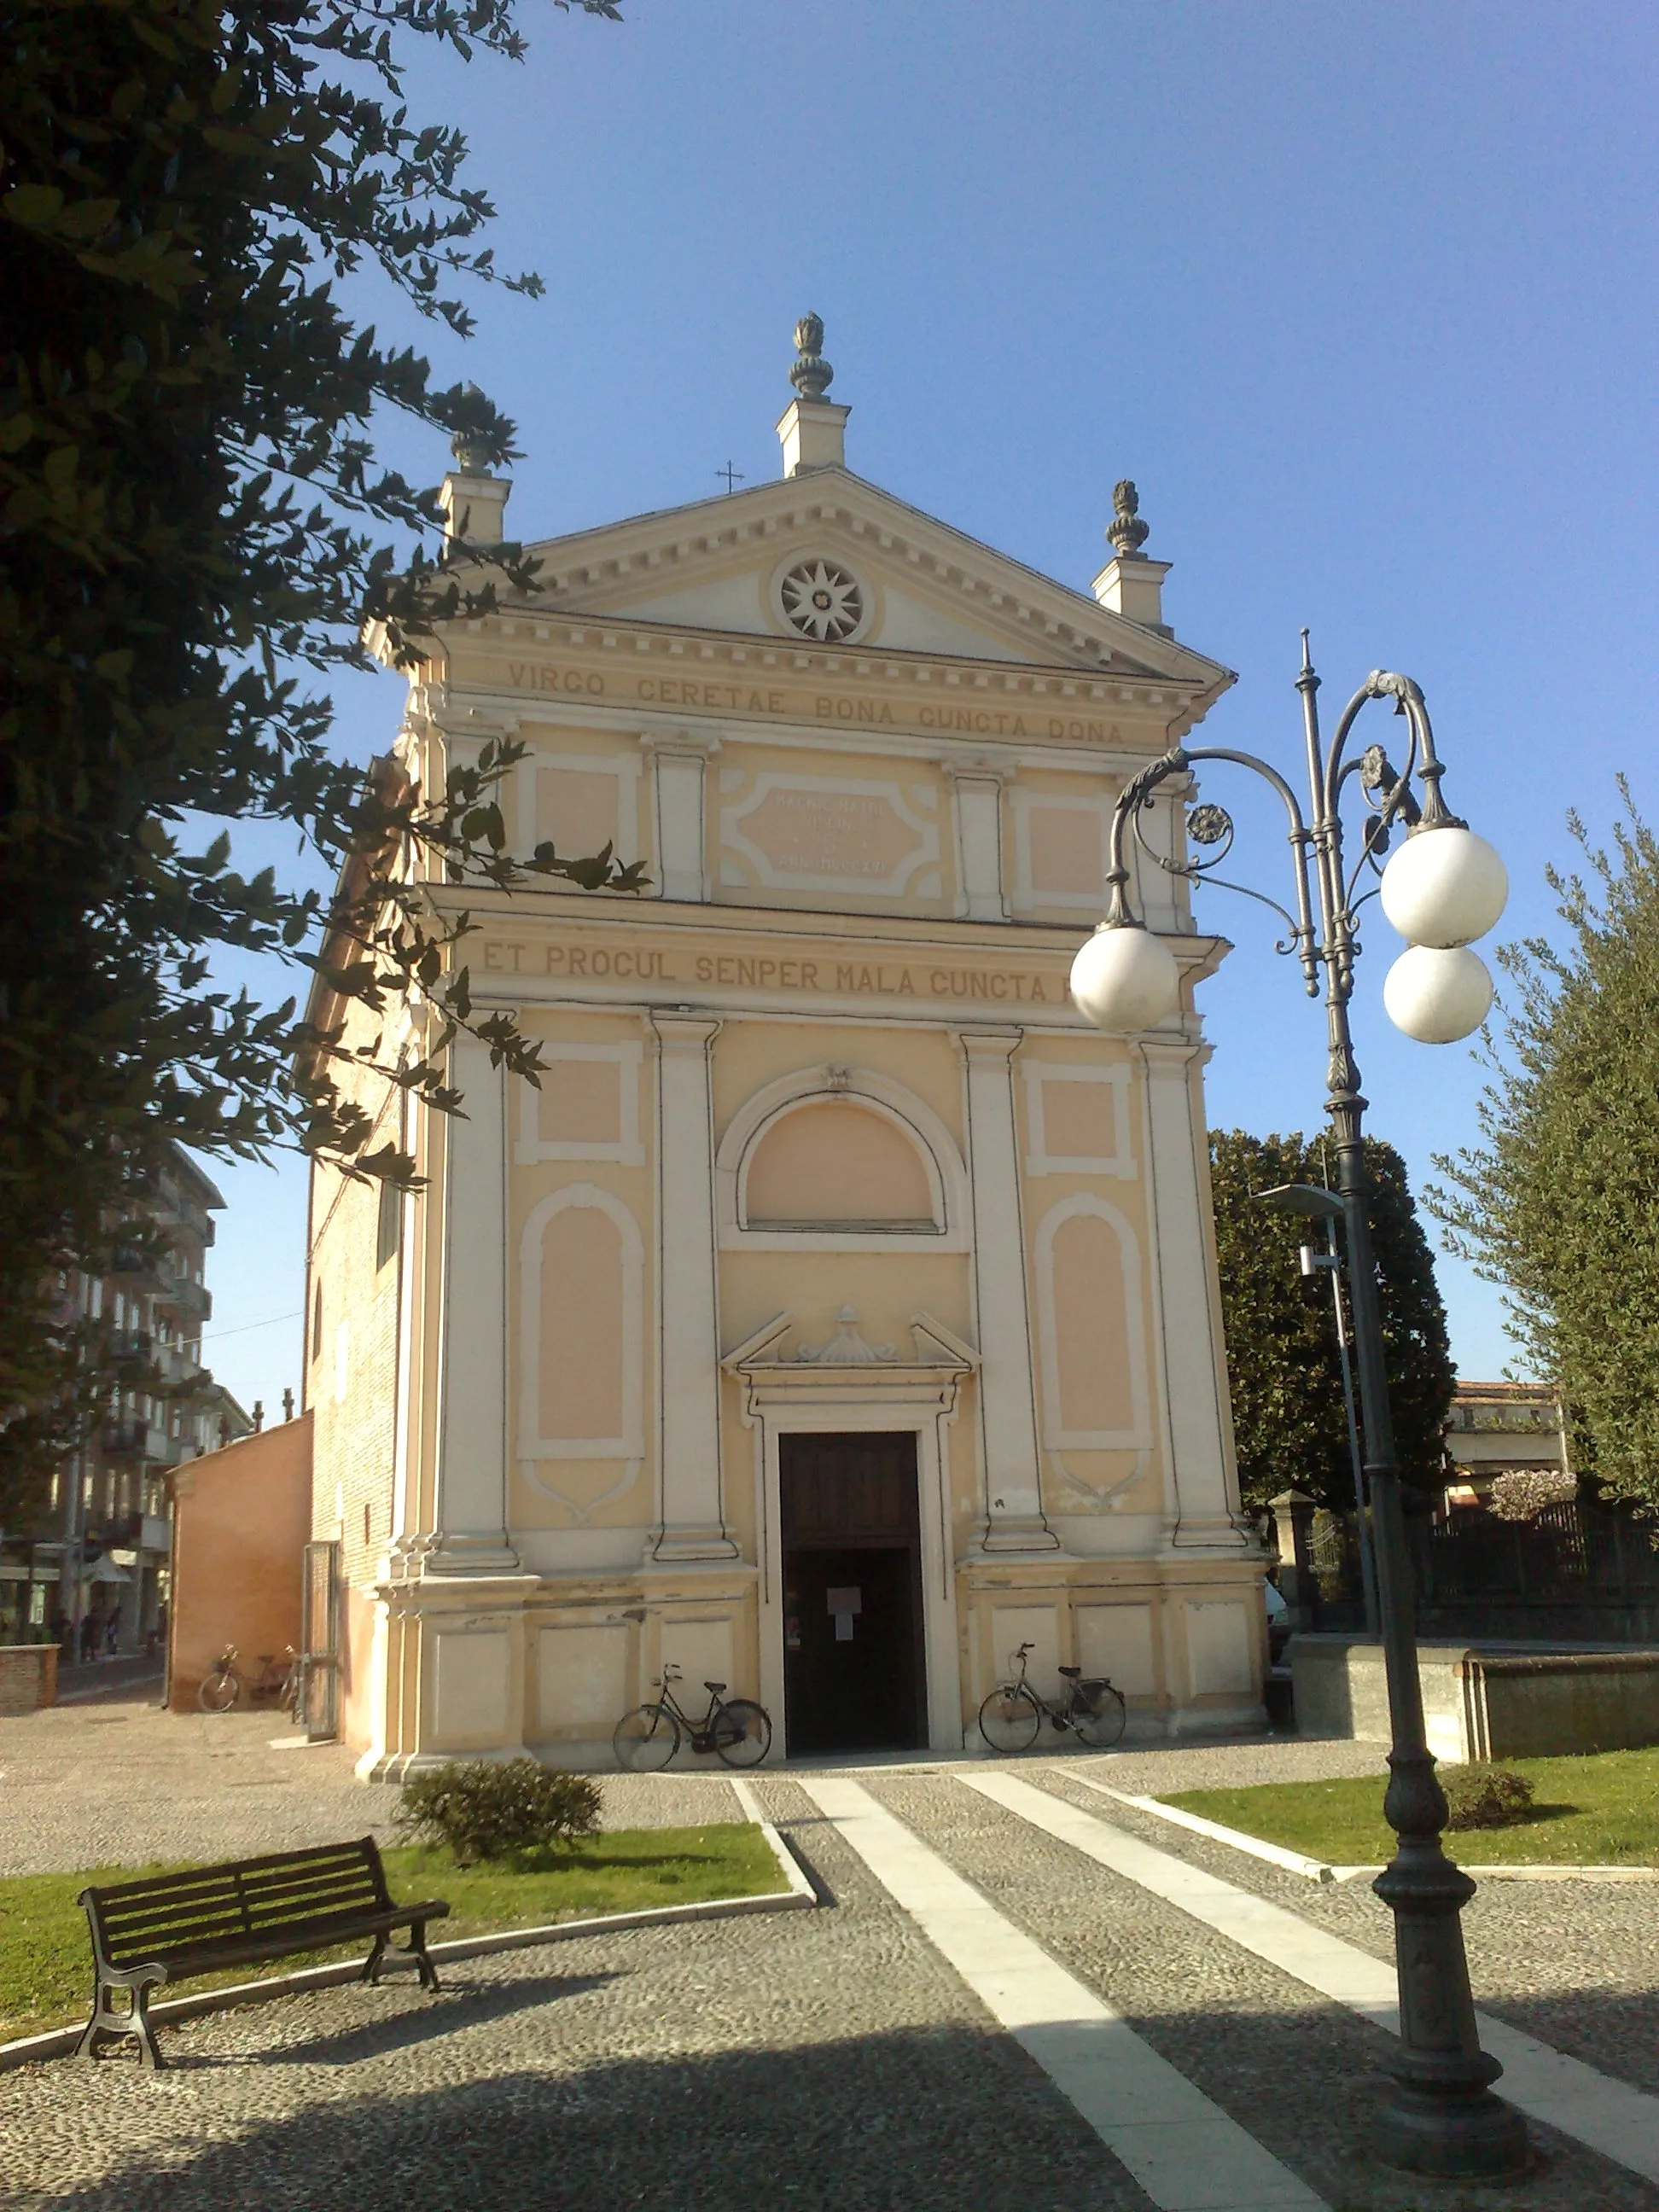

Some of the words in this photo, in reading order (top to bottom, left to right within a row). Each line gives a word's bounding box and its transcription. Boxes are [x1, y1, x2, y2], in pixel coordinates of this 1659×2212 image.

[508, 664, 604, 696] VIRGO
[637, 679, 786, 713] CERETAE
[815, 696, 895, 725] BONA
[919, 707, 1028, 736] CUNCTA
[1049, 719, 1124, 744] DONA
[483, 943, 527, 971] ET
[546, 946, 676, 981] PROCUL
[835, 964, 917, 995] MALA
[930, 970, 1047, 1002] CUNCTA
